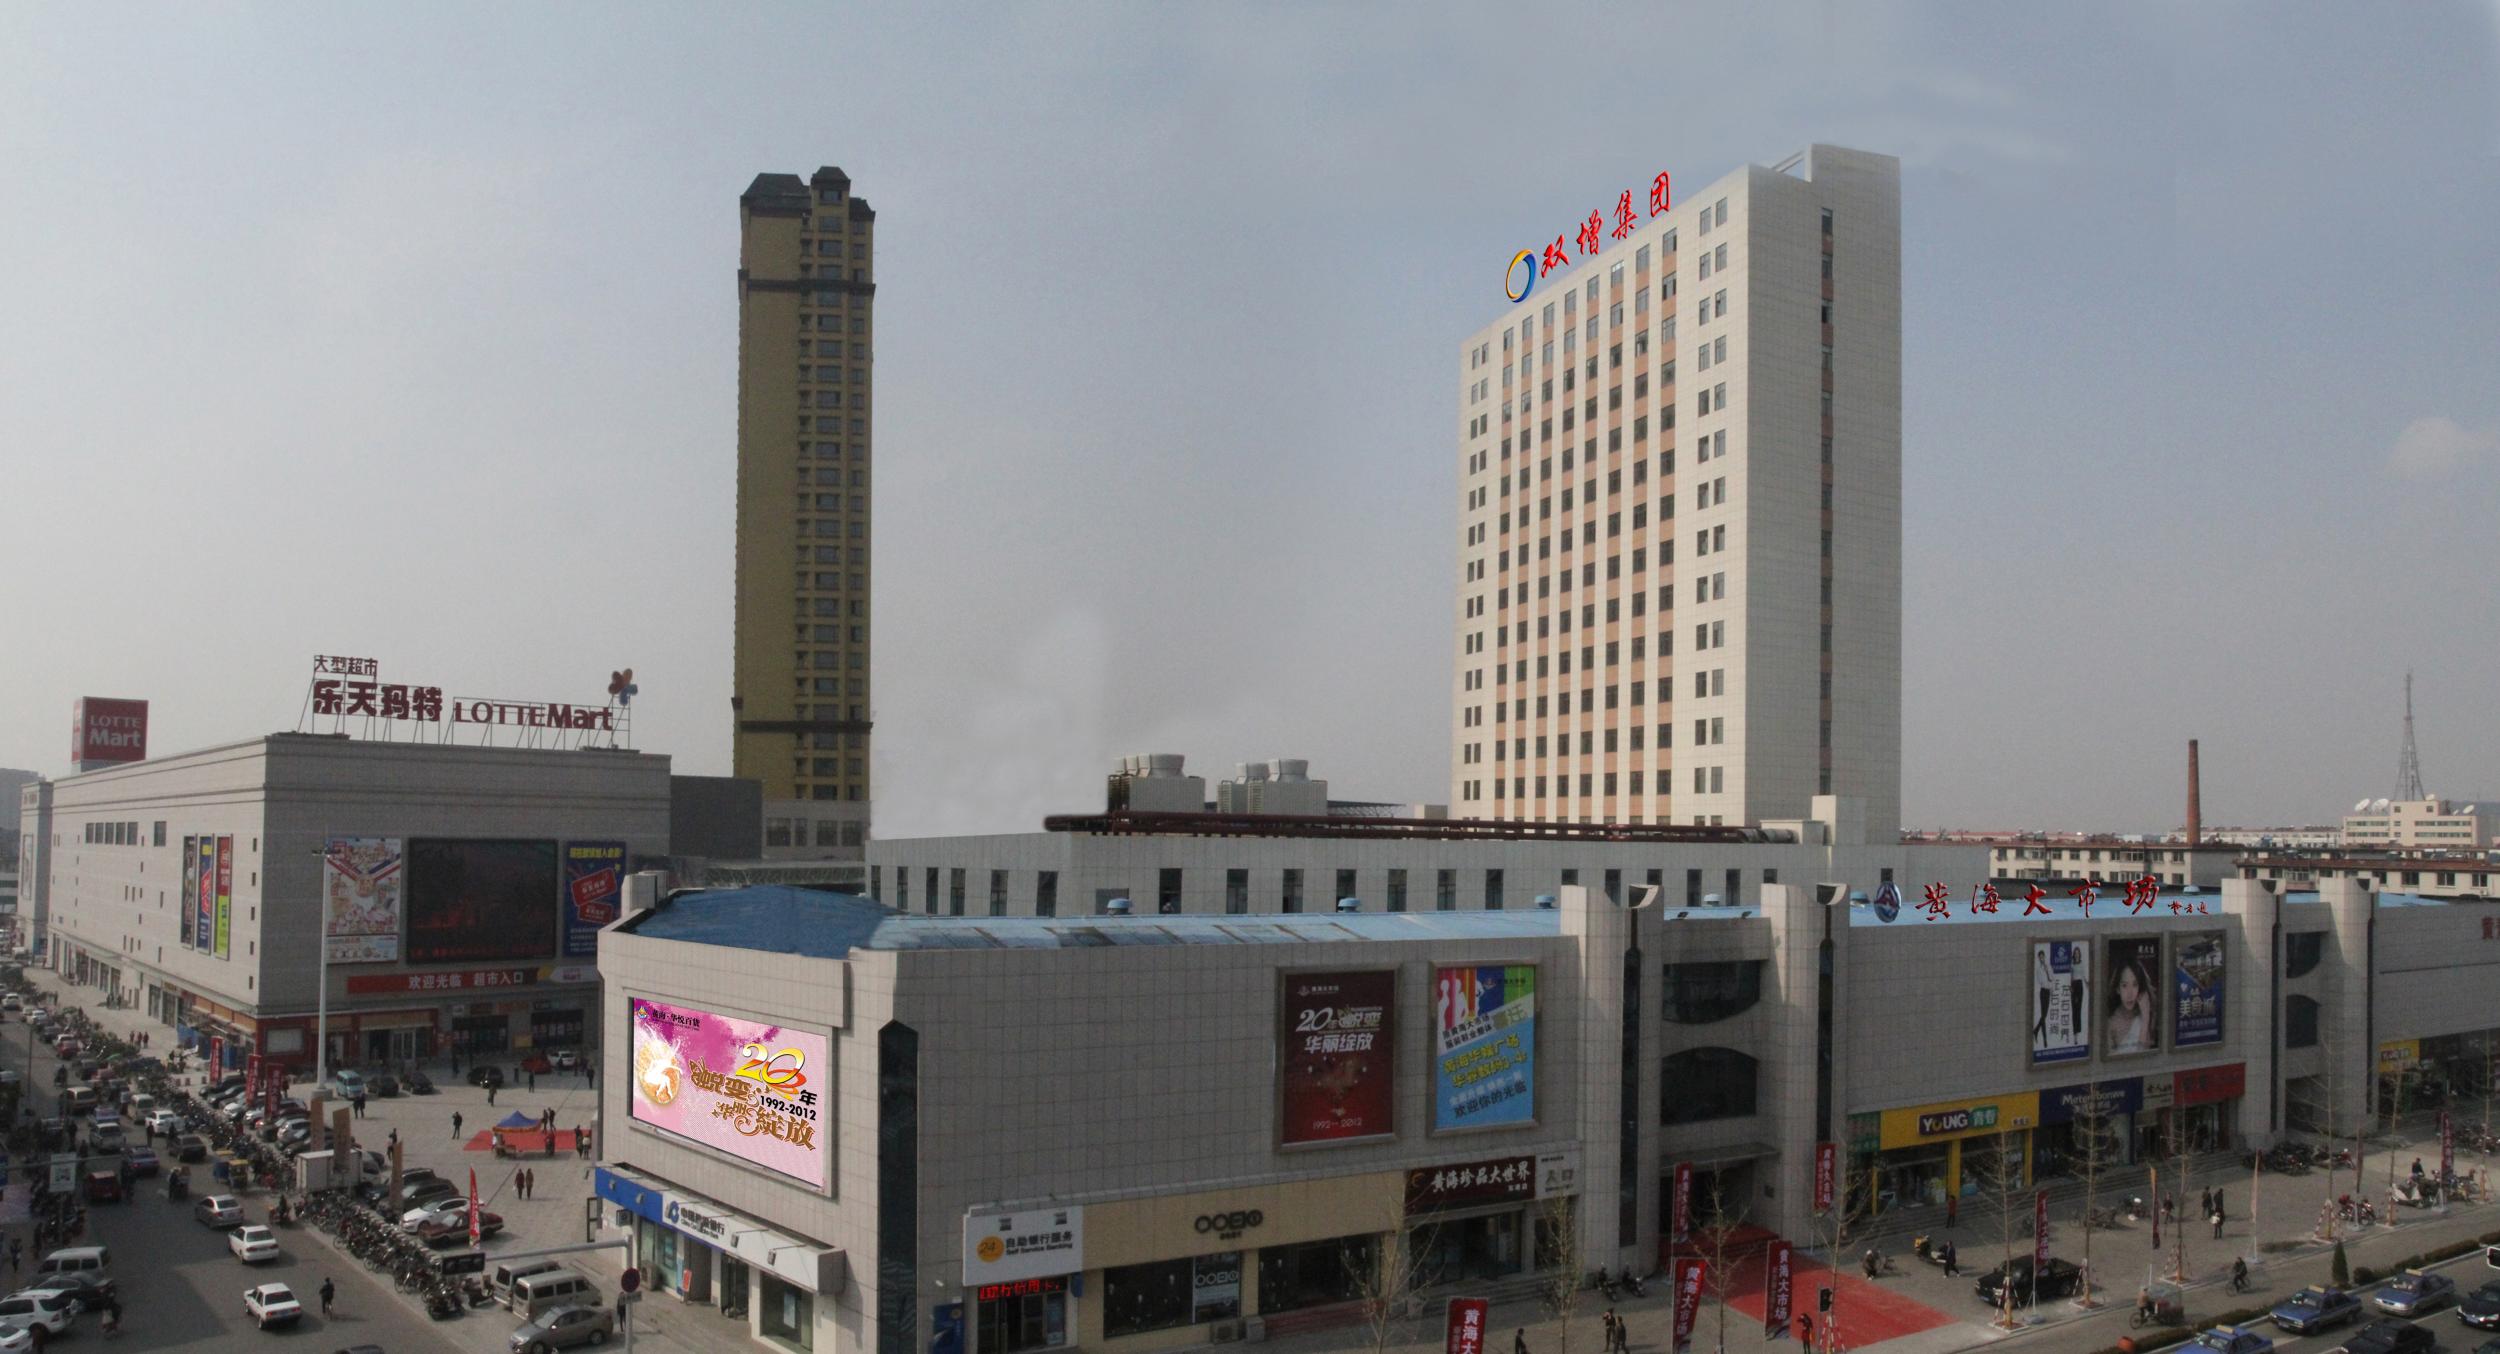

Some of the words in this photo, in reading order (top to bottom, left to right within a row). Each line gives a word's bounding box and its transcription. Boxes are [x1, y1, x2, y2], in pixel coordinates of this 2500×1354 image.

[313, 655, 378, 676] 大型超市
[313, 680, 443, 722] 乐天玛特
[90, 715, 142, 729] LOTTE
[89, 728, 141, 747] Mart
[1915, 875, 2160, 921] 黄海大市场
[408, 974, 462, 991] 欢迎光临
[473, 971, 524, 987] 超市入口
[1304, 1033, 1374, 1054] 华丽绽放
[760, 1095, 817, 1121] 1992-2012
[712, 1101, 817, 1152] 华丽绽放
[1923, 1112, 1969, 1132] YOUNG
[1006, 1231, 1073, 1248] 自助银行服务
[1775, 1248, 1790, 1320] 黄海大市场
[1677, 1266, 1700, 1337] 黄海大市场
